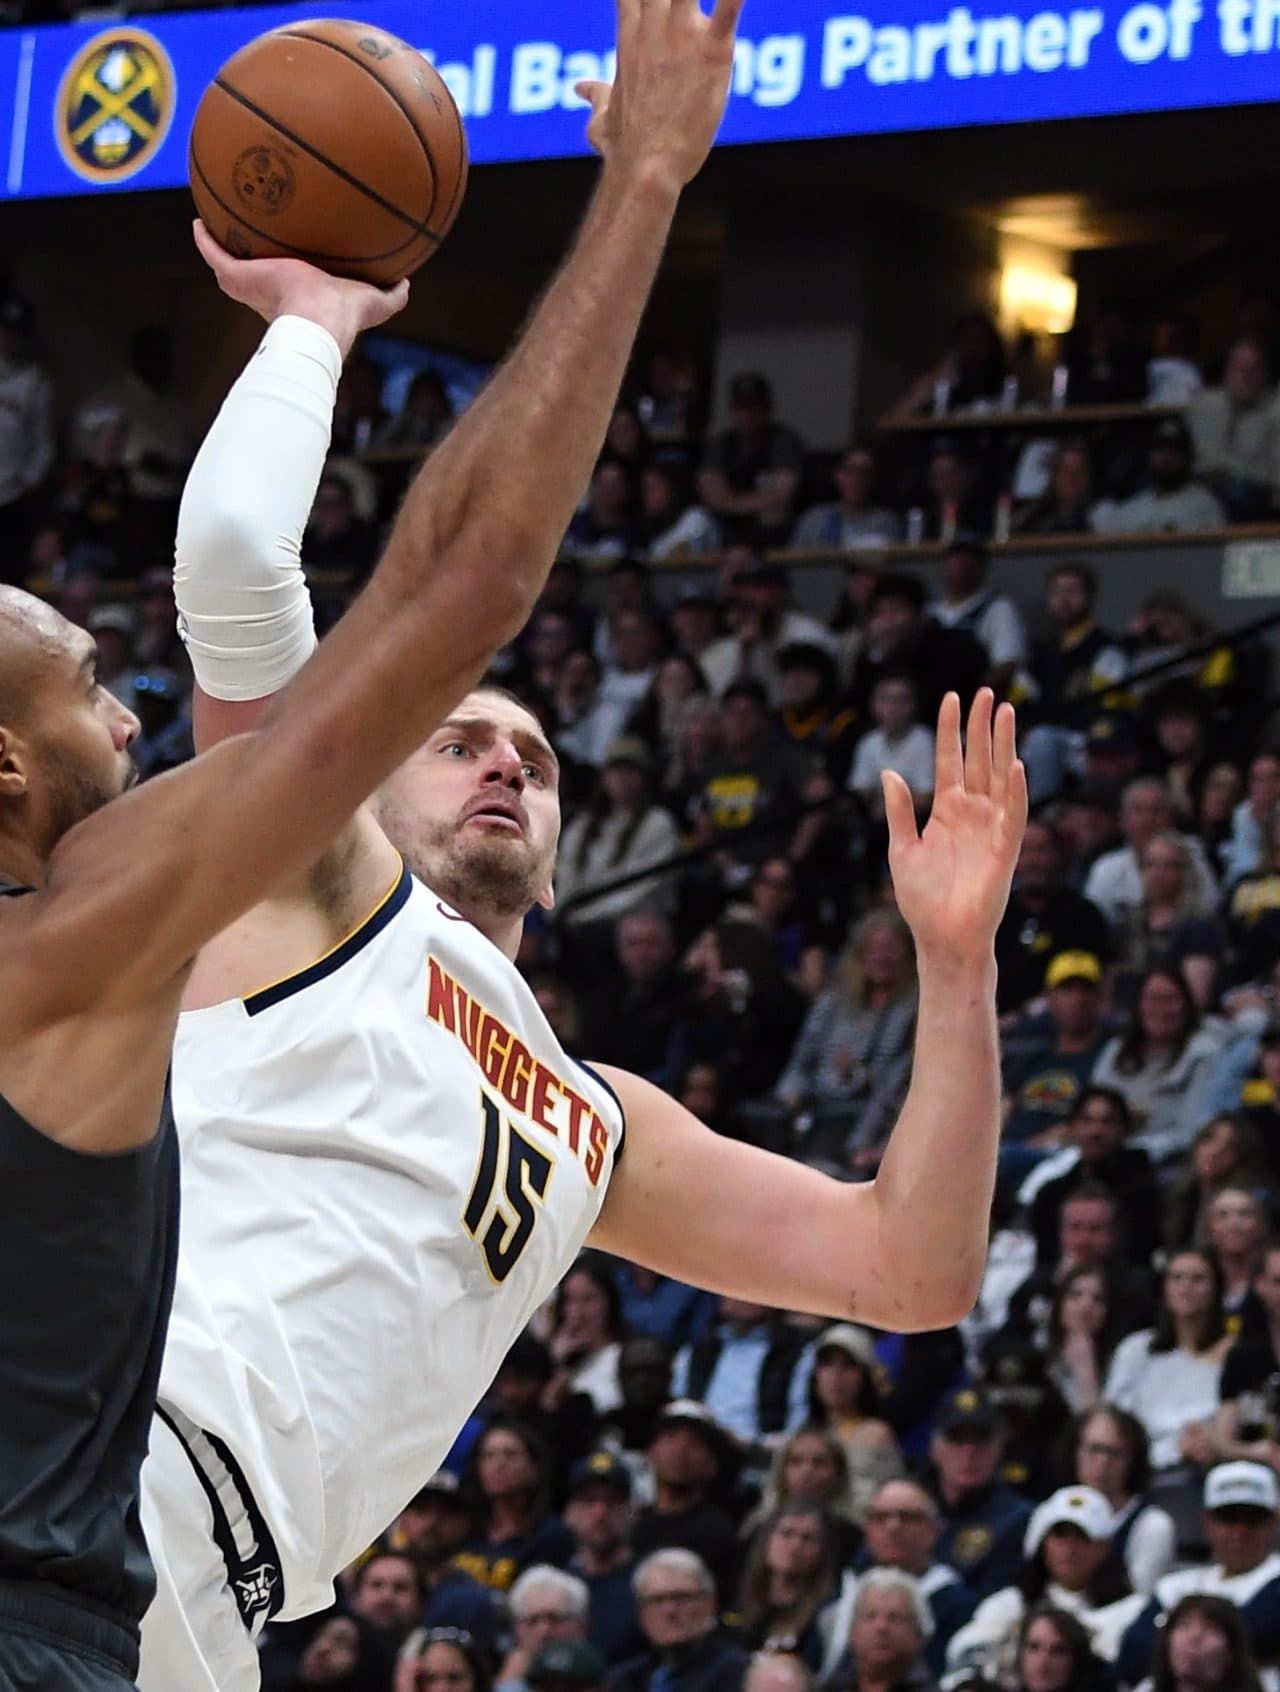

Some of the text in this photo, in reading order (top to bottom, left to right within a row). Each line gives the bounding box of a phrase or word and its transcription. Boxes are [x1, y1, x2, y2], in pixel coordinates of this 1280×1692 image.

[821, 6, 1104, 89] Partner
[1117, 0, 1202, 64] of
[427, 955, 610, 1187] NUGGETS
[461, 1088, 557, 1287] 15
